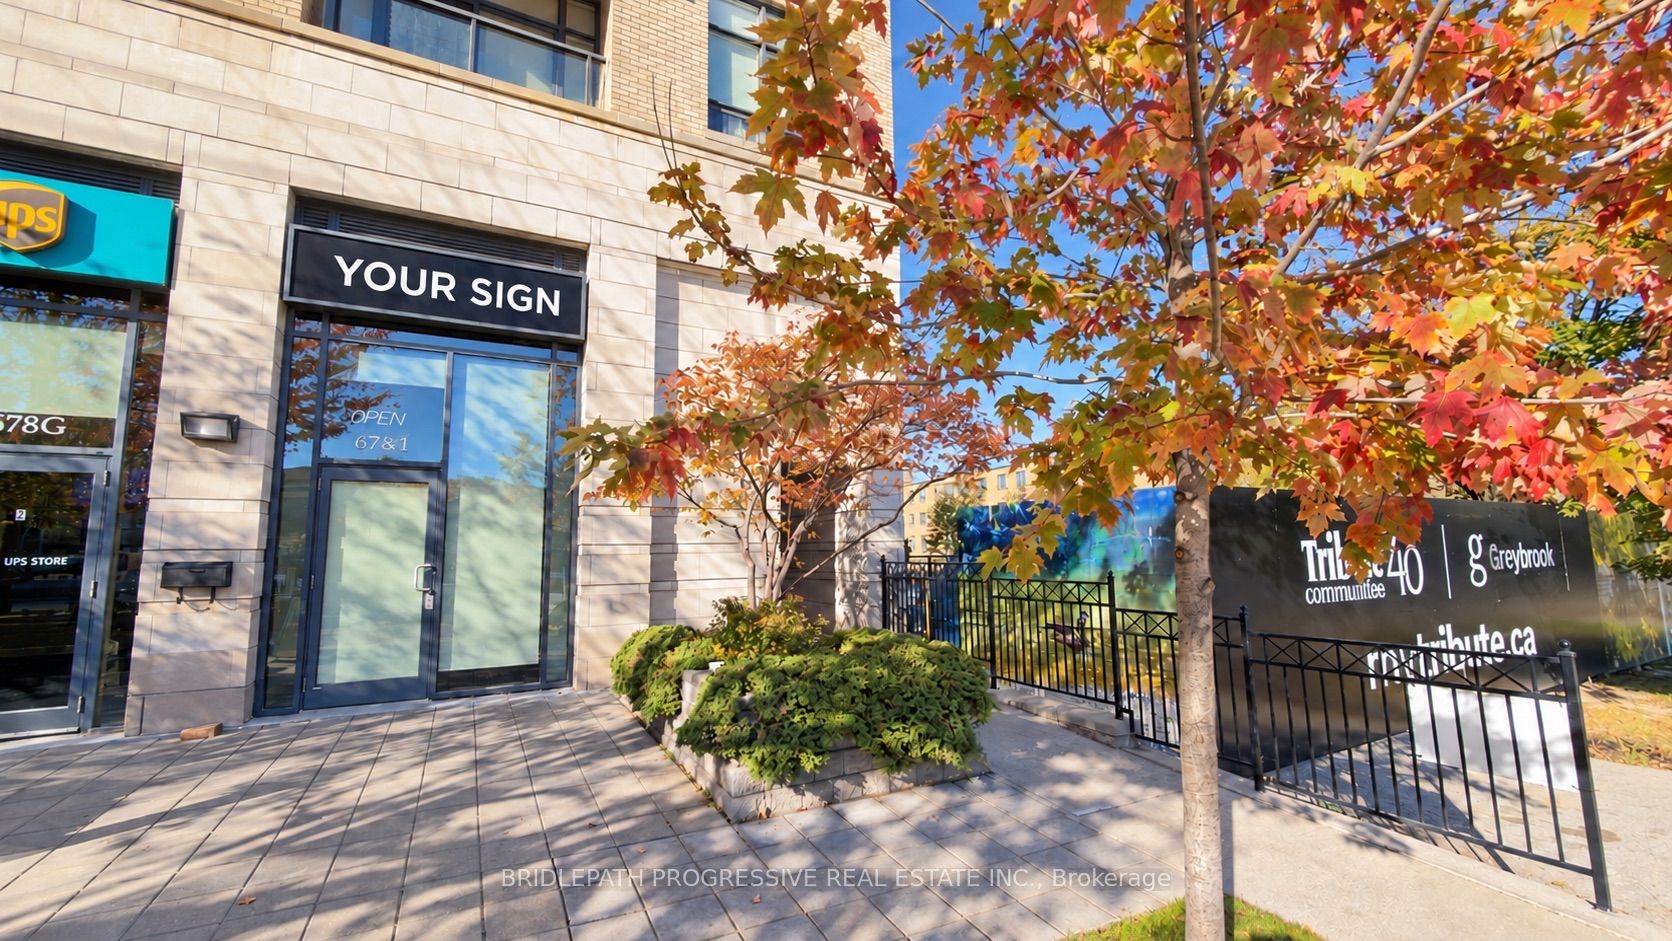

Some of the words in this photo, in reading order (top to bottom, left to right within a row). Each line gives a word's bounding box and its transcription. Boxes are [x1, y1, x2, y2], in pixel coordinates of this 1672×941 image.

[334, 255, 455, 302] YOUR
[470, 278, 560, 316] SIGN
[351, 409, 406, 426] OPEN
[17, 510, 24, 520] 2
[4, 557, 28, 566] UPS
[30, 556, 68, 566] STORE
[1489, 541, 1555, 575] Greybrook
